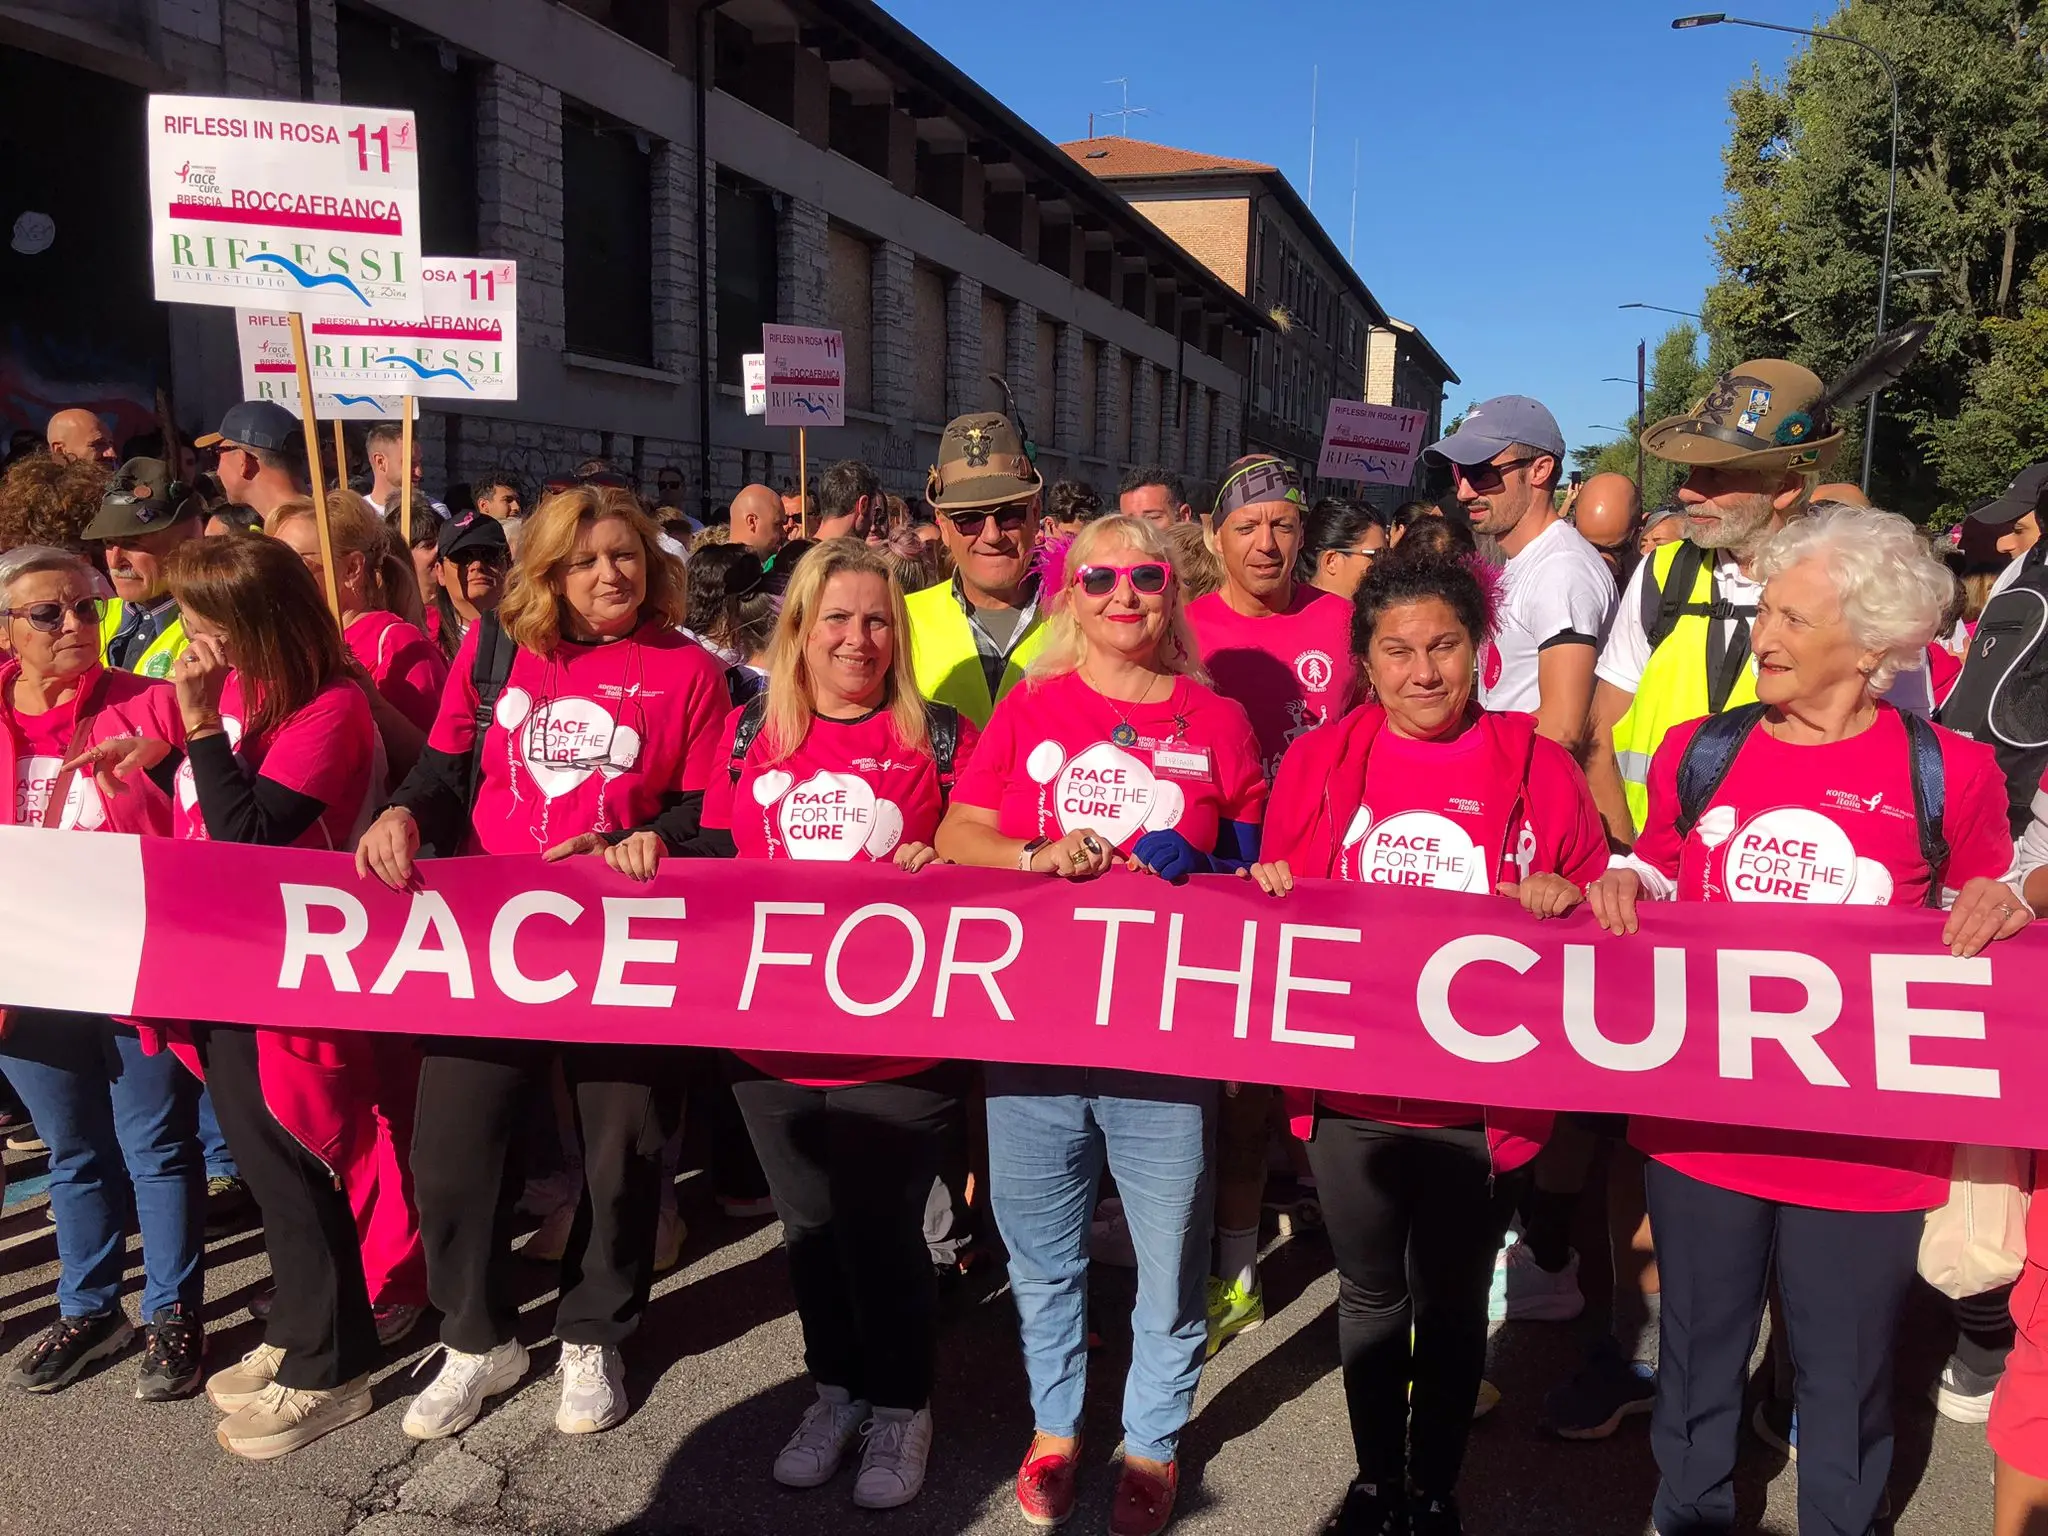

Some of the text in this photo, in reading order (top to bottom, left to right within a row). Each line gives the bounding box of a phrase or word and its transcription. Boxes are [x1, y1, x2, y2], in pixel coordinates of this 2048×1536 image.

[164, 115, 341, 145] RIFLESSI IN ROSA
[347, 123, 391, 174] 11
[189, 172, 216, 186] race
[199, 184, 221, 194] cure
[176, 188, 401, 221] BRESCIA ROCCAFRANCA
[169, 233, 406, 284] RIFLESSI
[422, 268, 458, 283] OSA
[462, 268, 495, 302] 11
[248, 315, 292, 327] RIFLE
[319, 317, 361, 327] BRESCIA
[769, 333, 796, 345] RIFLESSI
[805, 336, 823, 347] ROSA
[824, 335, 837, 359] 11
[312, 344, 503, 374] RIFLESSI
[789, 367, 840, 380] ROCCAFRANCA
[771, 391, 841, 409] RIFLESSI
[1334, 405, 1368, 418] RIFLESSI
[1377, 412, 1398, 422] ROSA
[1400, 414, 1416, 434] 11
[1352, 434, 1411, 450] ROCCAFRANCA
[536, 717, 589, 734] RACE
[532, 732, 606, 748] FOR THE
[622, 752, 635, 767] 025
[1070, 767, 1127, 784] RACE
[1168, 768, 1203, 777] VOLONTARIA
[16, 778, 58, 792] ACE
[1067, 781, 1149, 804] FOR THE
[15, 794, 39, 808] OR
[792, 789, 848, 805] RACE
[790, 806, 868, 824] FOR THE
[1063, 798, 1122, 819] CURE
[1164, 808, 1180, 827] 2025
[789, 824, 844, 840] CURE
[884, 829, 900, 849] 2025
[1376, 832, 1441, 853] RACE
[1742, 834, 1819, 861] RACE
[1373, 849, 1465, 874] FOR THE
[1738, 852, 1846, 886] FOR THE
[1370, 867, 1436, 888] CURE
[1735, 873, 1812, 901] CURE
[276, 880, 2001, 1100] RACE FOR THE CURE
